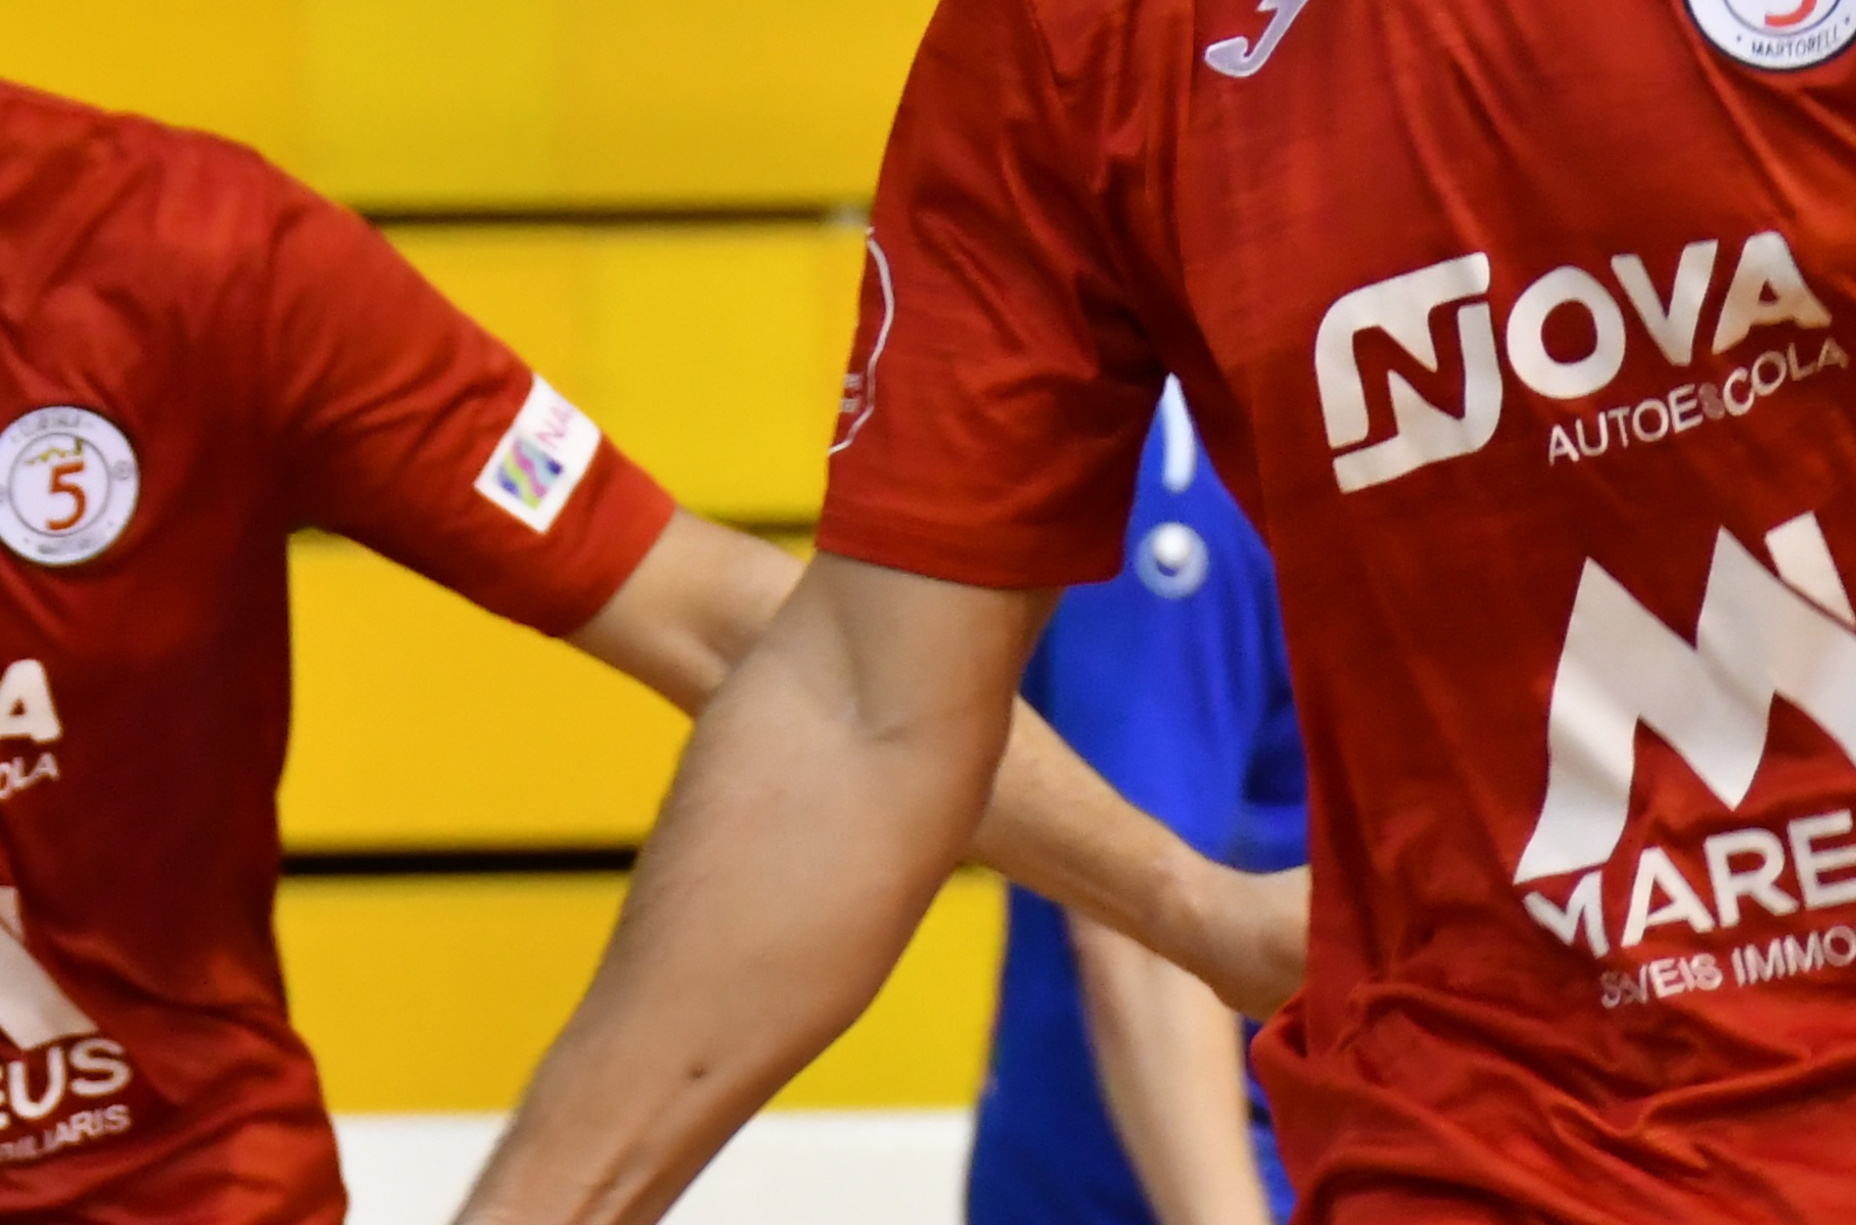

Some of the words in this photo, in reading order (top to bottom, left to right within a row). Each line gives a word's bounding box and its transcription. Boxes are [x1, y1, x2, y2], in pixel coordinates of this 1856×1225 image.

[1751, 26, 1841, 58] MARTORELL
[1315, 231, 1832, 494] NOVA
[47, 460, 87, 531] 5
